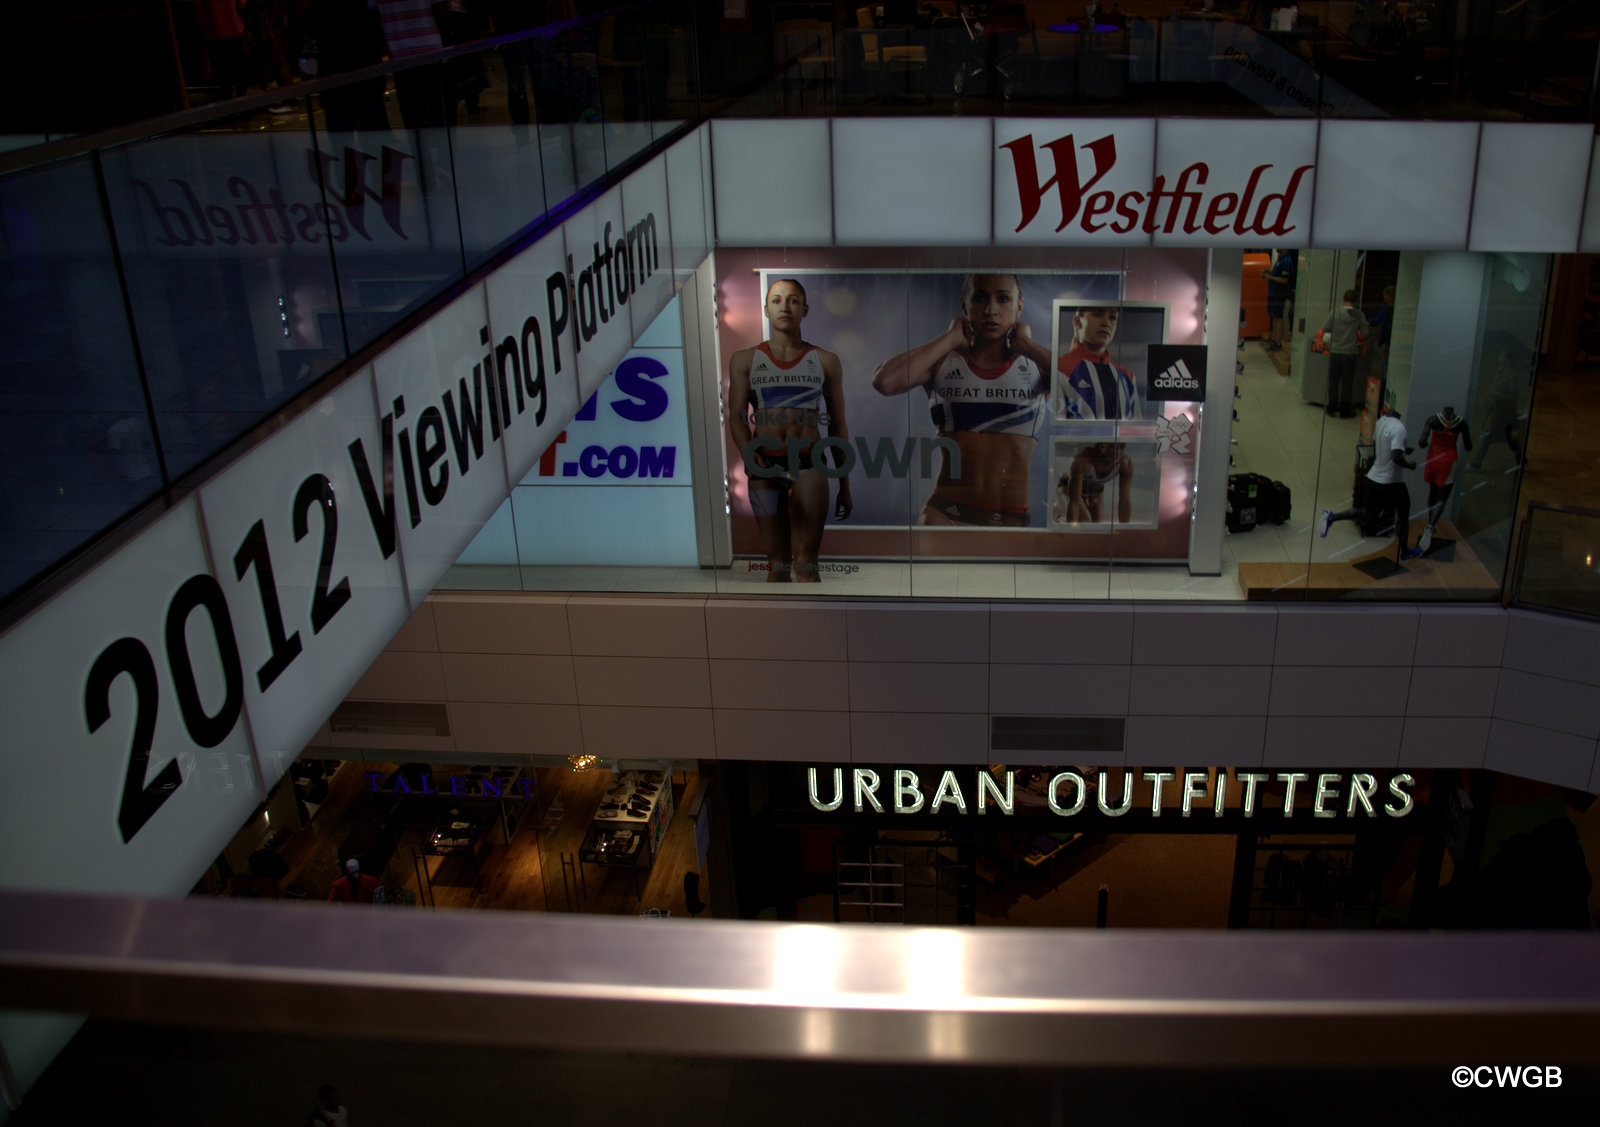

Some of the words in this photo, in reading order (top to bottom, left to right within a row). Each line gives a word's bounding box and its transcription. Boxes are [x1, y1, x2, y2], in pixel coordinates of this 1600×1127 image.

[999, 134, 1315, 235] Westfield
[751, 375, 781, 385] GREAT
[784, 375, 822, 385] BRITAIN
[939, 387, 980, 398] GREAT
[986, 387, 1038, 399] BRITAIN
[1154, 377, 1200, 389] adidas
[740, 410, 790, 426] take
[796, 410, 832, 426] the
[743, 435, 962, 480] crown
[85, 473, 351, 844] 2012
[348, 316, 547, 560] Viewing
[546, 212, 658, 375] Platform
[363, 772, 536, 799] TALENT
[807, 767, 1014, 815] URBAN
[1048, 771, 1416, 819] OUTFITTERS
